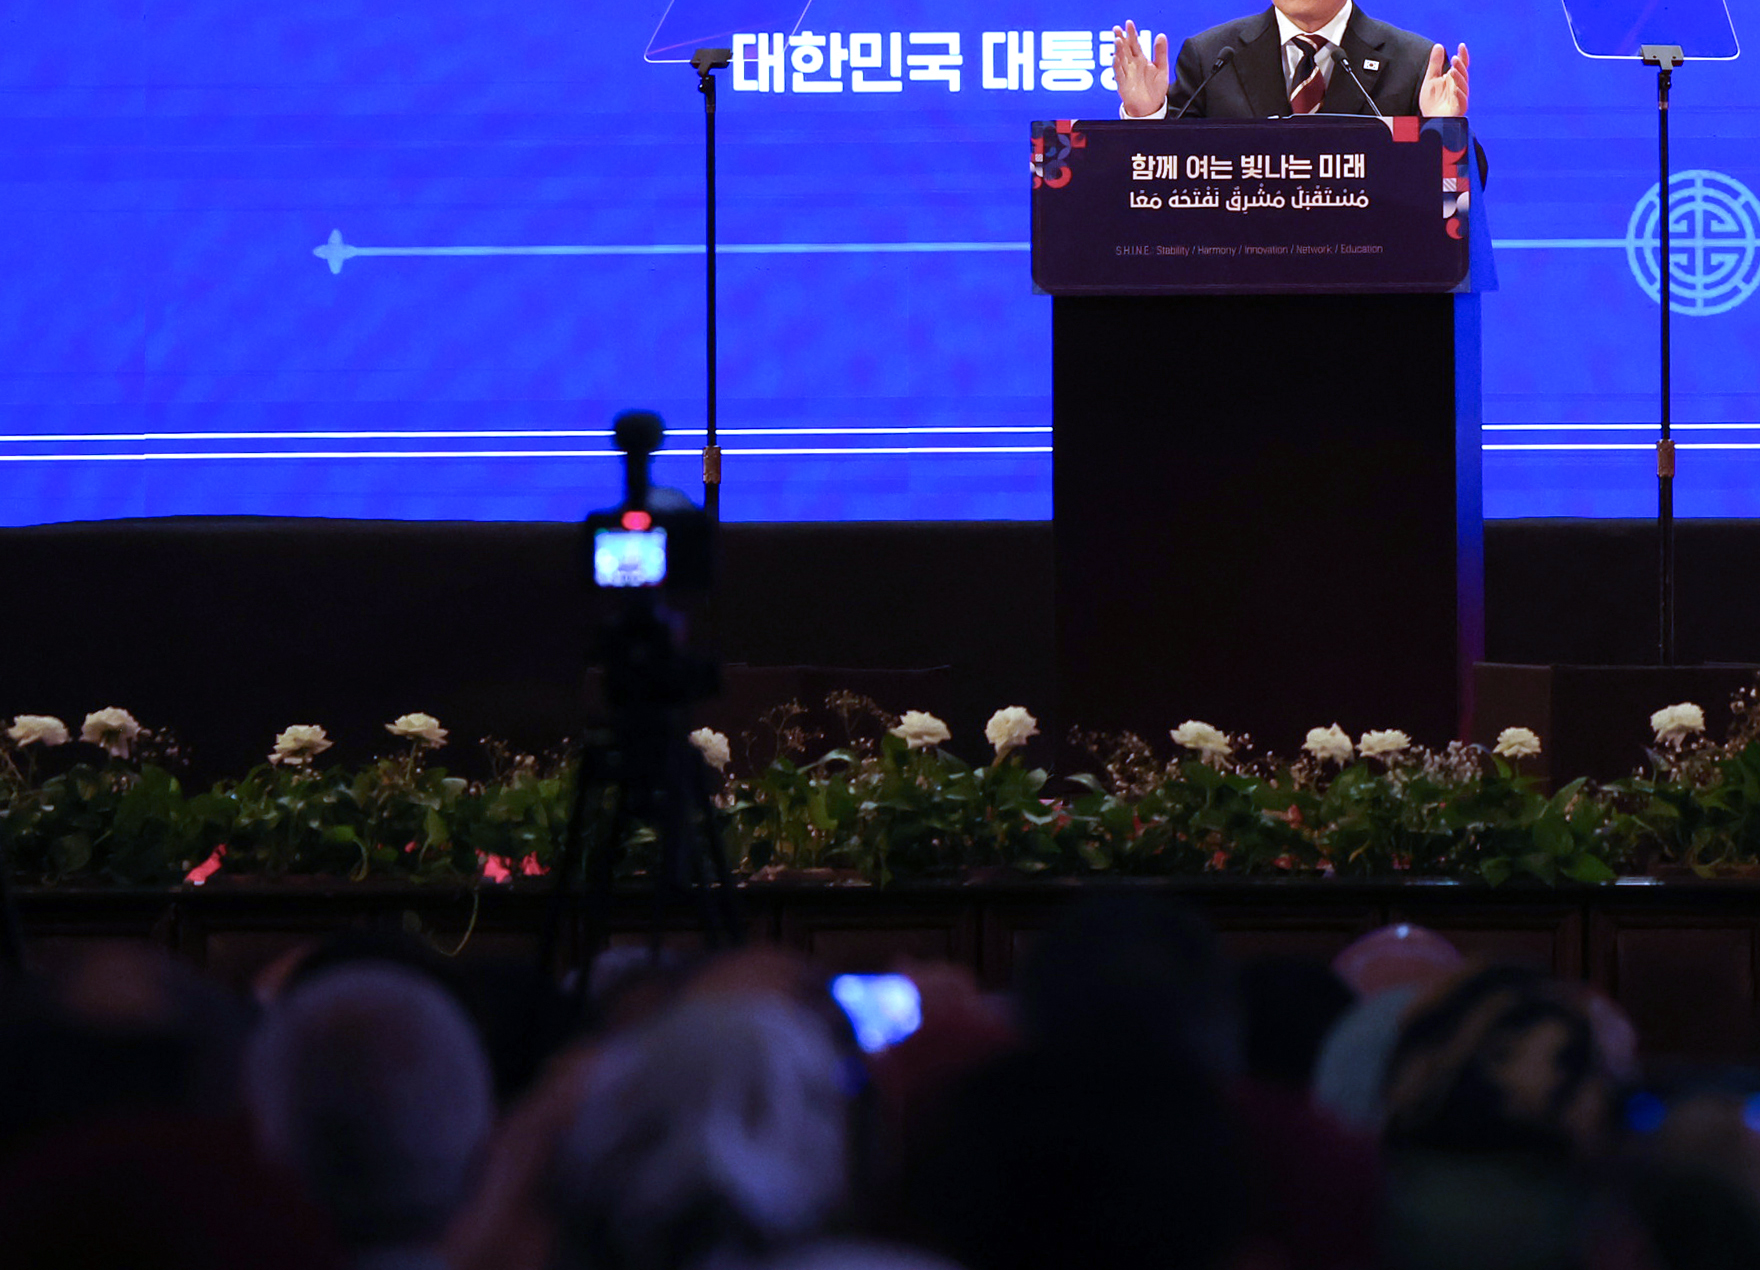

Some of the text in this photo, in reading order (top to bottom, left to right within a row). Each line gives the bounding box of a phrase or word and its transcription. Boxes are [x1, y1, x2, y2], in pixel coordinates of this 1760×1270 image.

[732, 31, 963, 93] 대한민국
[1131, 153, 1365, 181] 함께 여는 빛나는 미래
[1156, 245, 1190, 257] Stability
[1197, 245, 1237, 257] Harmony
[1244, 245, 1288, 255] Innovation
[1296, 244, 1333, 254] Network
[1340, 243, 1384, 254] Education
